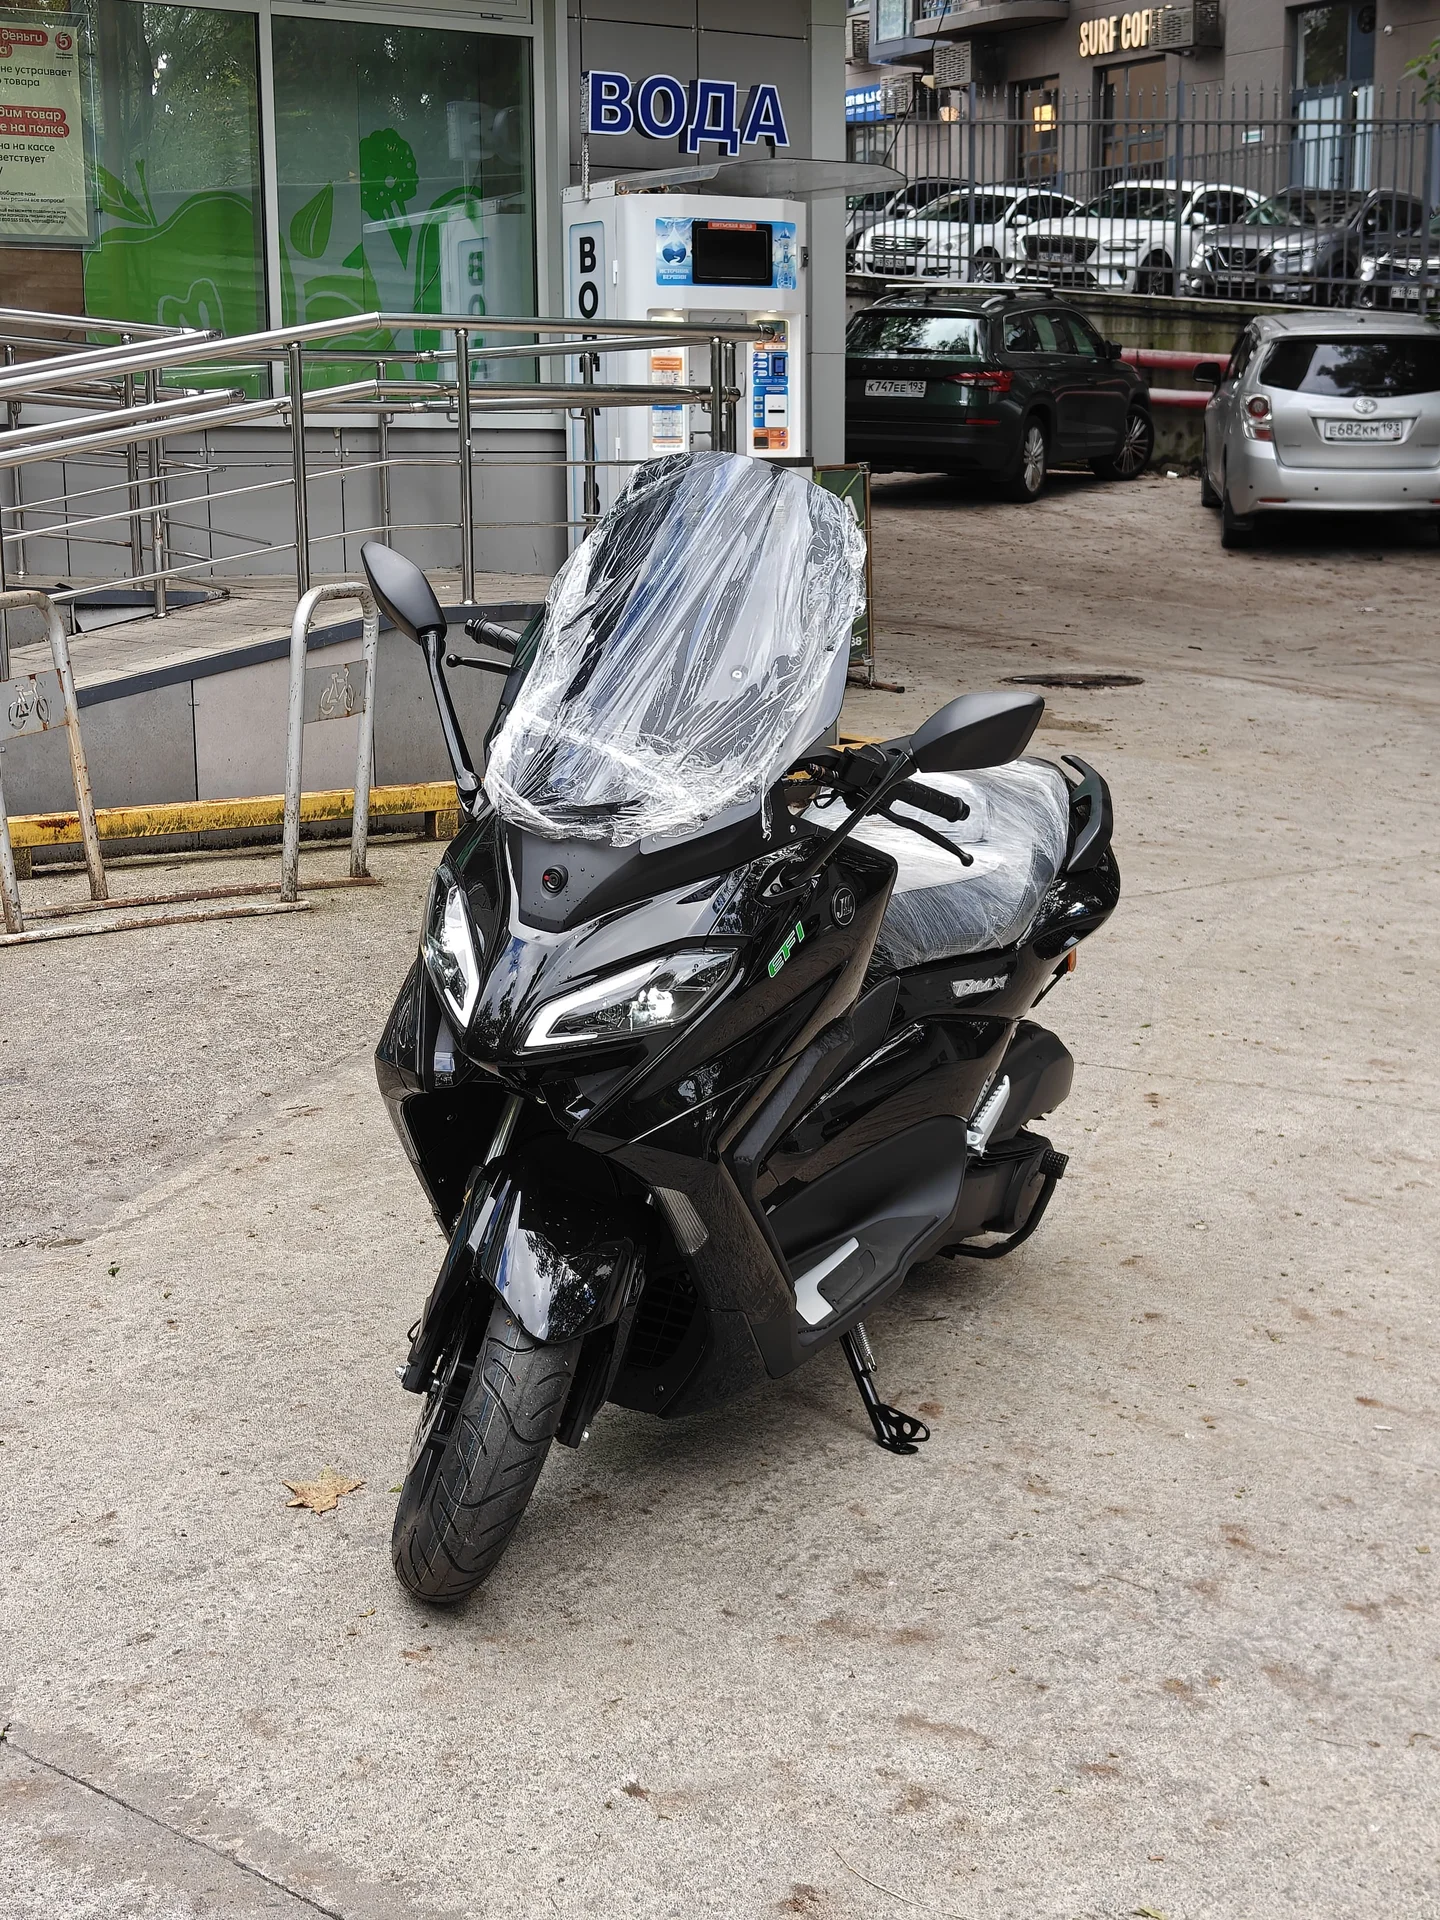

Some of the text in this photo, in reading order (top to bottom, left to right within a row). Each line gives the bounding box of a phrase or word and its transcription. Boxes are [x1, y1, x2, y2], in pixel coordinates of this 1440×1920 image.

[2, 29, 42, 42] деньги
[1080, 8, 1160, 57] SURF COF
[15, 66, 72, 77] устраивает
[4, 78, 40, 88] товара
[25, 110, 61, 122] товар
[588, 70, 790, 156] ВОДА
[11, 123, 25, 132] на
[29, 124, 65, 135] полке
[13, 143, 25, 151] на
[28, 144, 55, 152] кассе
[867, 381, 924, 393] К747ЕЕ 193
[1329, 423, 1379, 436] Е682КМ
[768, 920, 805, 978] EFI
